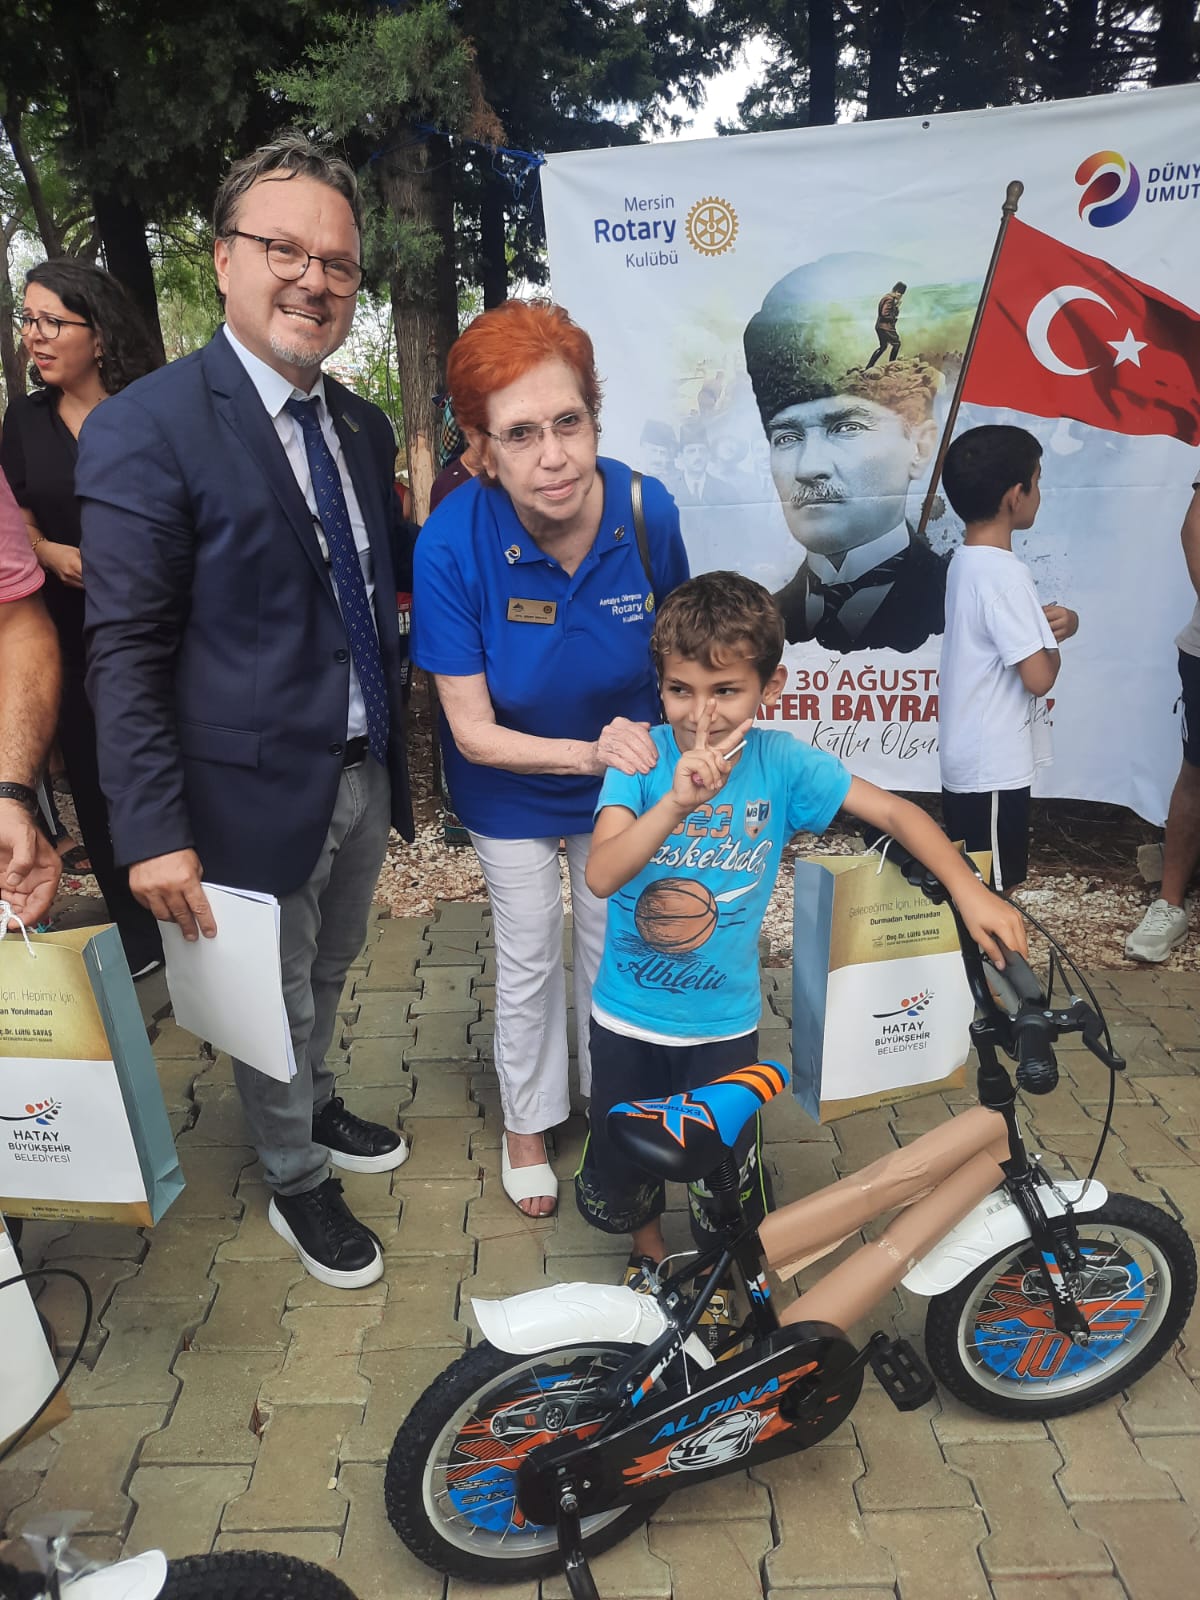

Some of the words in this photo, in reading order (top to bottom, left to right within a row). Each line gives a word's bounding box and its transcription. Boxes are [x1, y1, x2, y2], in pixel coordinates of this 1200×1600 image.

[624, 194, 675, 212] Mersin
[594, 219, 677, 244] Rotary
[625, 250, 679, 268] Kulübü
[611, 602, 643, 616] Rotary
[796, 669, 829, 691] 30
[837, 665, 940, 692] AĞUST
[810, 720, 870, 760] Kutlu
[881, 720, 939, 760] Olsu
[671, 803, 734, 839] 23
[649, 835, 773, 875] asketball
[870, 915, 903, 926] Durmadan
[904, 910, 941, 921] Yorulmadan
[617, 953, 728, 995] Athletic
[10, 1007, 53, 1017] Yorulmadan
[882, 1021, 924, 1035] HATAY
[874, 1031, 931, 1047] BÜYÜKŞEHİR
[877, 1040, 927, 1056] BELEDİYESİ
[13, 1129, 60, 1142] HATAY
[8, 1141, 72, 1154] BÜYÜKŞEHİR
[14, 1152, 71, 1163] BELEDİYESİ
[1014, 1329, 1073, 1379] 10
[649, 1376, 780, 1445] ALPINA
